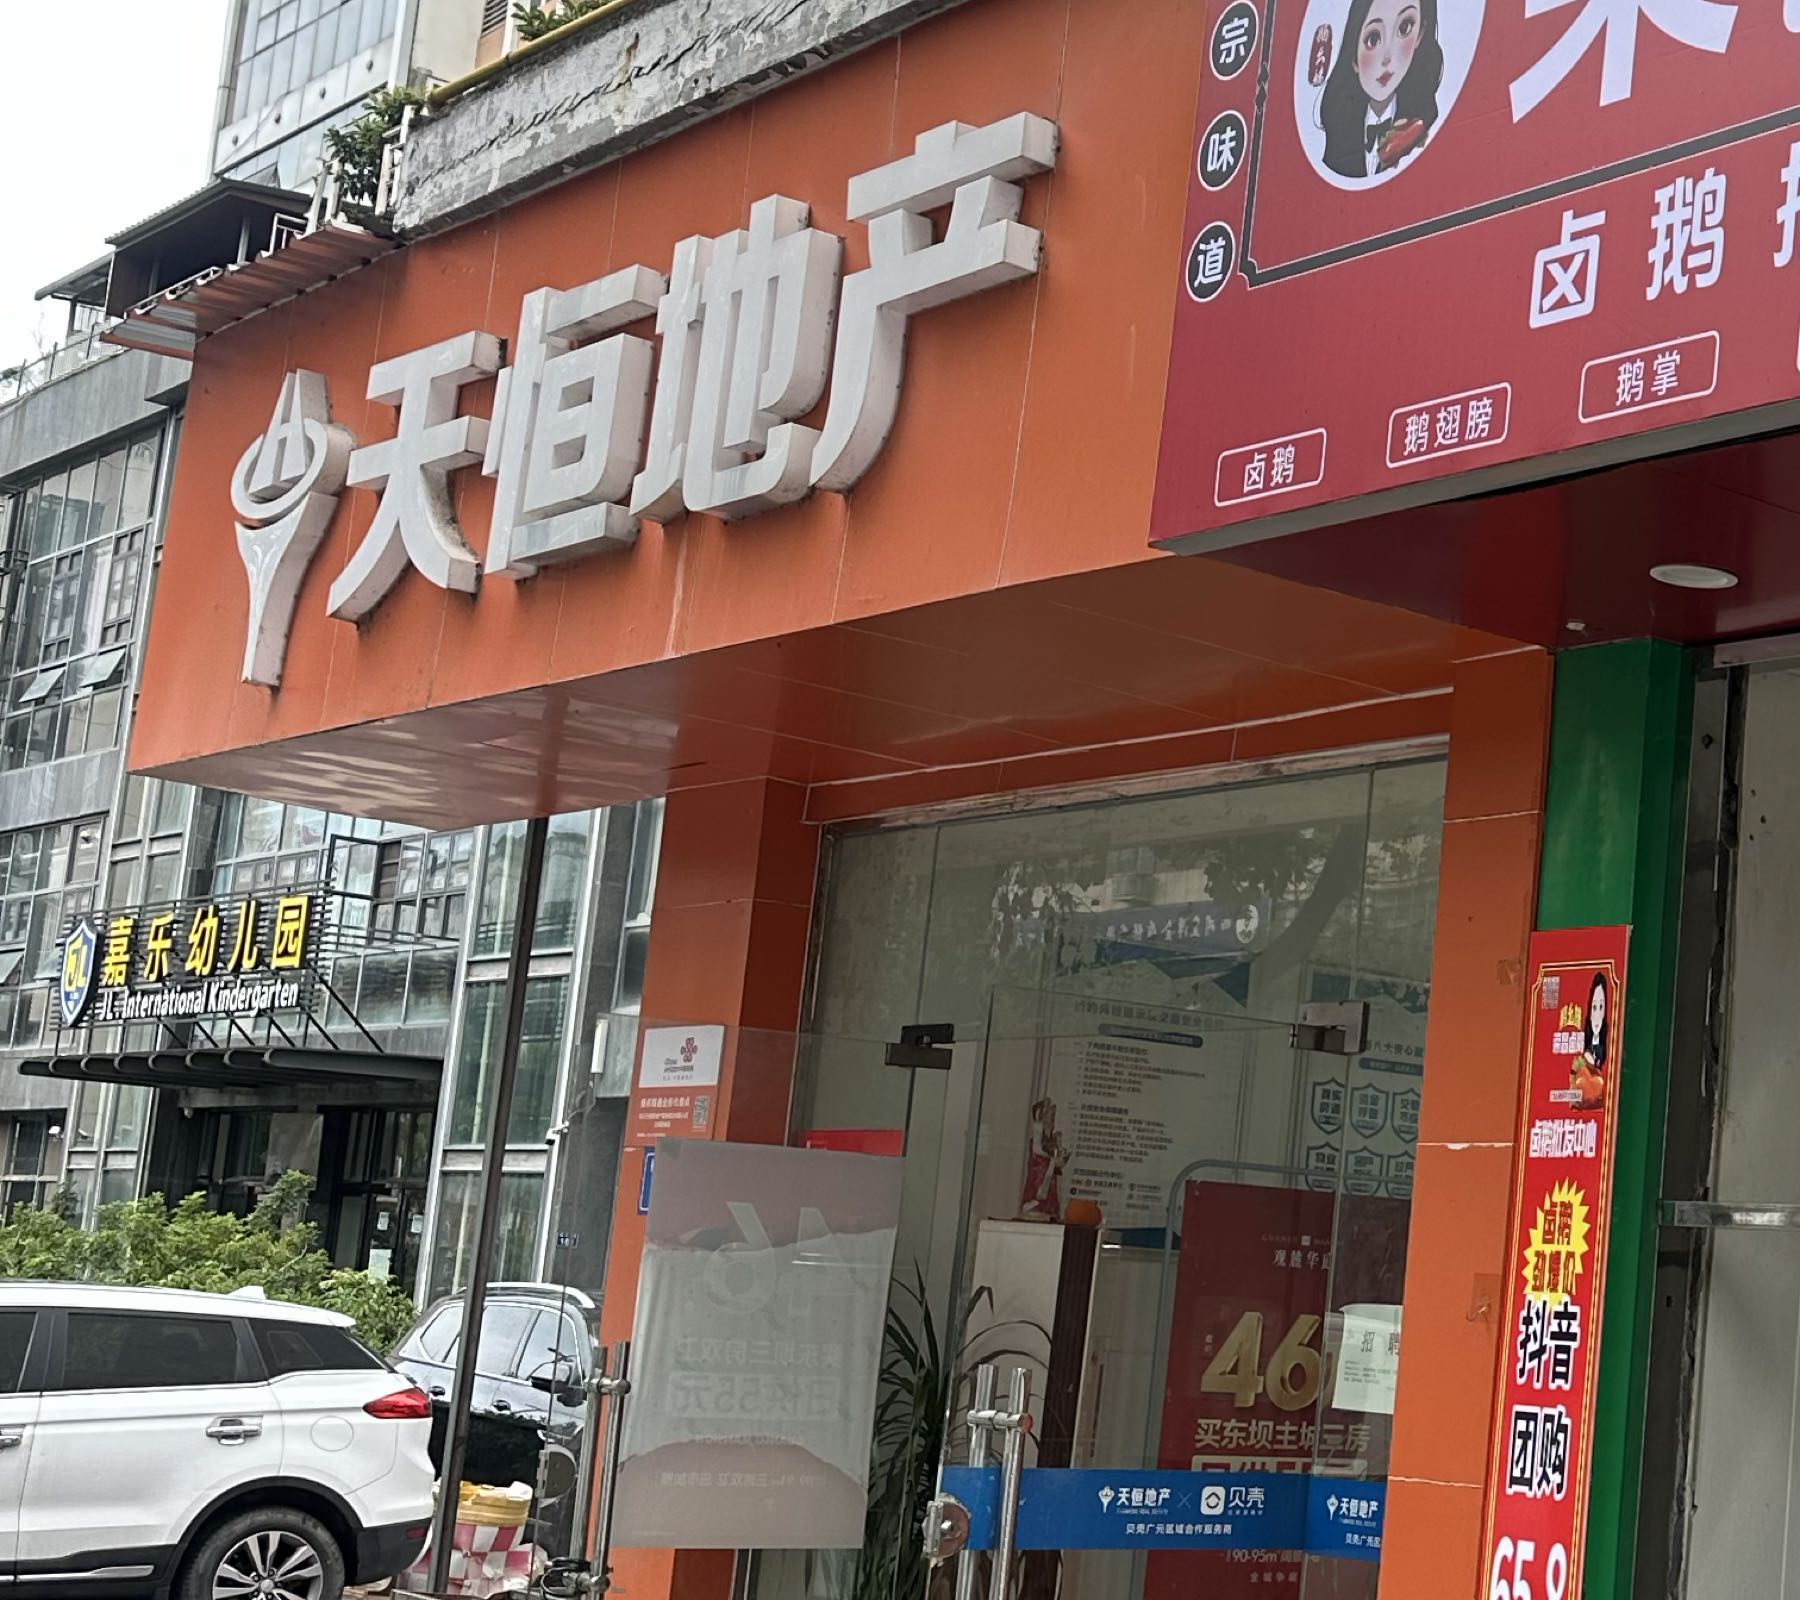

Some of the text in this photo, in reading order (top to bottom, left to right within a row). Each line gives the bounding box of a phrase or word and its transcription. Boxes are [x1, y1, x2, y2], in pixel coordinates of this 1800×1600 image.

[327, 111, 1059, 623] 天恒地产
[1614, 349, 1681, 405] 鹅掌
[1402, 393, 1494, 457] 鹅翅膀
[1241, 445, 1297, 493] 卤鹅
[101, 896, 309, 988] 嘉乐幼儿园
[208, 979, 299, 1017] Kindergarten
[1516, 1296, 1581, 1391] 抖音
[1505, 1404, 1573, 1499] 团购
[1116, 1487, 1171, 1507] 天恒地产
[1227, 1486, 1265, 1509] 贝壳
